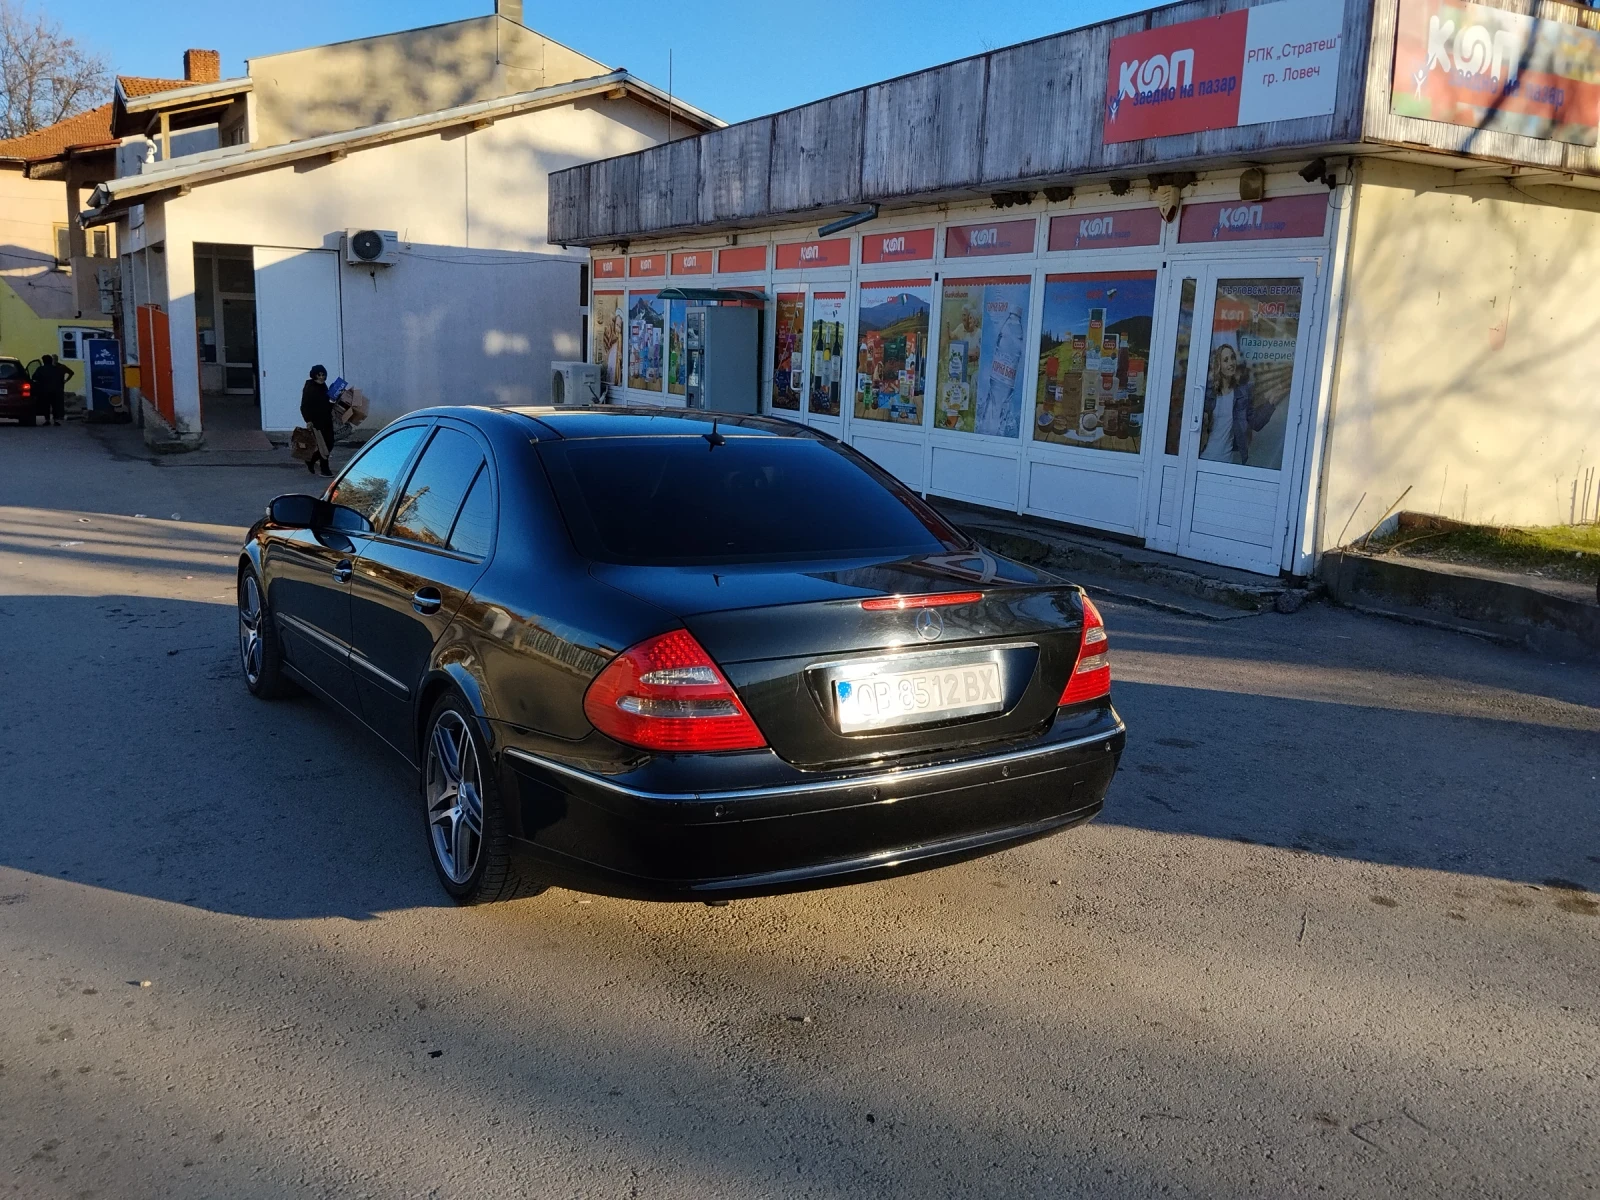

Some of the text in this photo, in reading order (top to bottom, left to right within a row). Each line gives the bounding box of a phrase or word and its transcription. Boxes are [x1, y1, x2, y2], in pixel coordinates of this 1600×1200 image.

[1248, 35, 1342, 63] РПК „Стратеш“
[1428, 15, 1520, 85] КОП
[1120, 48, 1195, 100] КОП
[1262, 66, 1321, 87] гр. Ловеч
[1132, 76, 1237, 107] заедно на пазар
[1219, 205, 1263, 228] КОП
[1079, 217, 1113, 238] КОП
[883, 237, 905, 253] КОП
[970, 228, 998, 246] КОП
[800, 245, 819, 260] КОП
[683, 256, 697, 268] КОП
[1222, 285, 1302, 295] ТЪРГОВСКА ВЕРИГА
[1221, 309, 1245, 320] КОП
[1257, 301, 1286, 315] КОП
[1241, 337, 1296, 349] Пазаруваме
